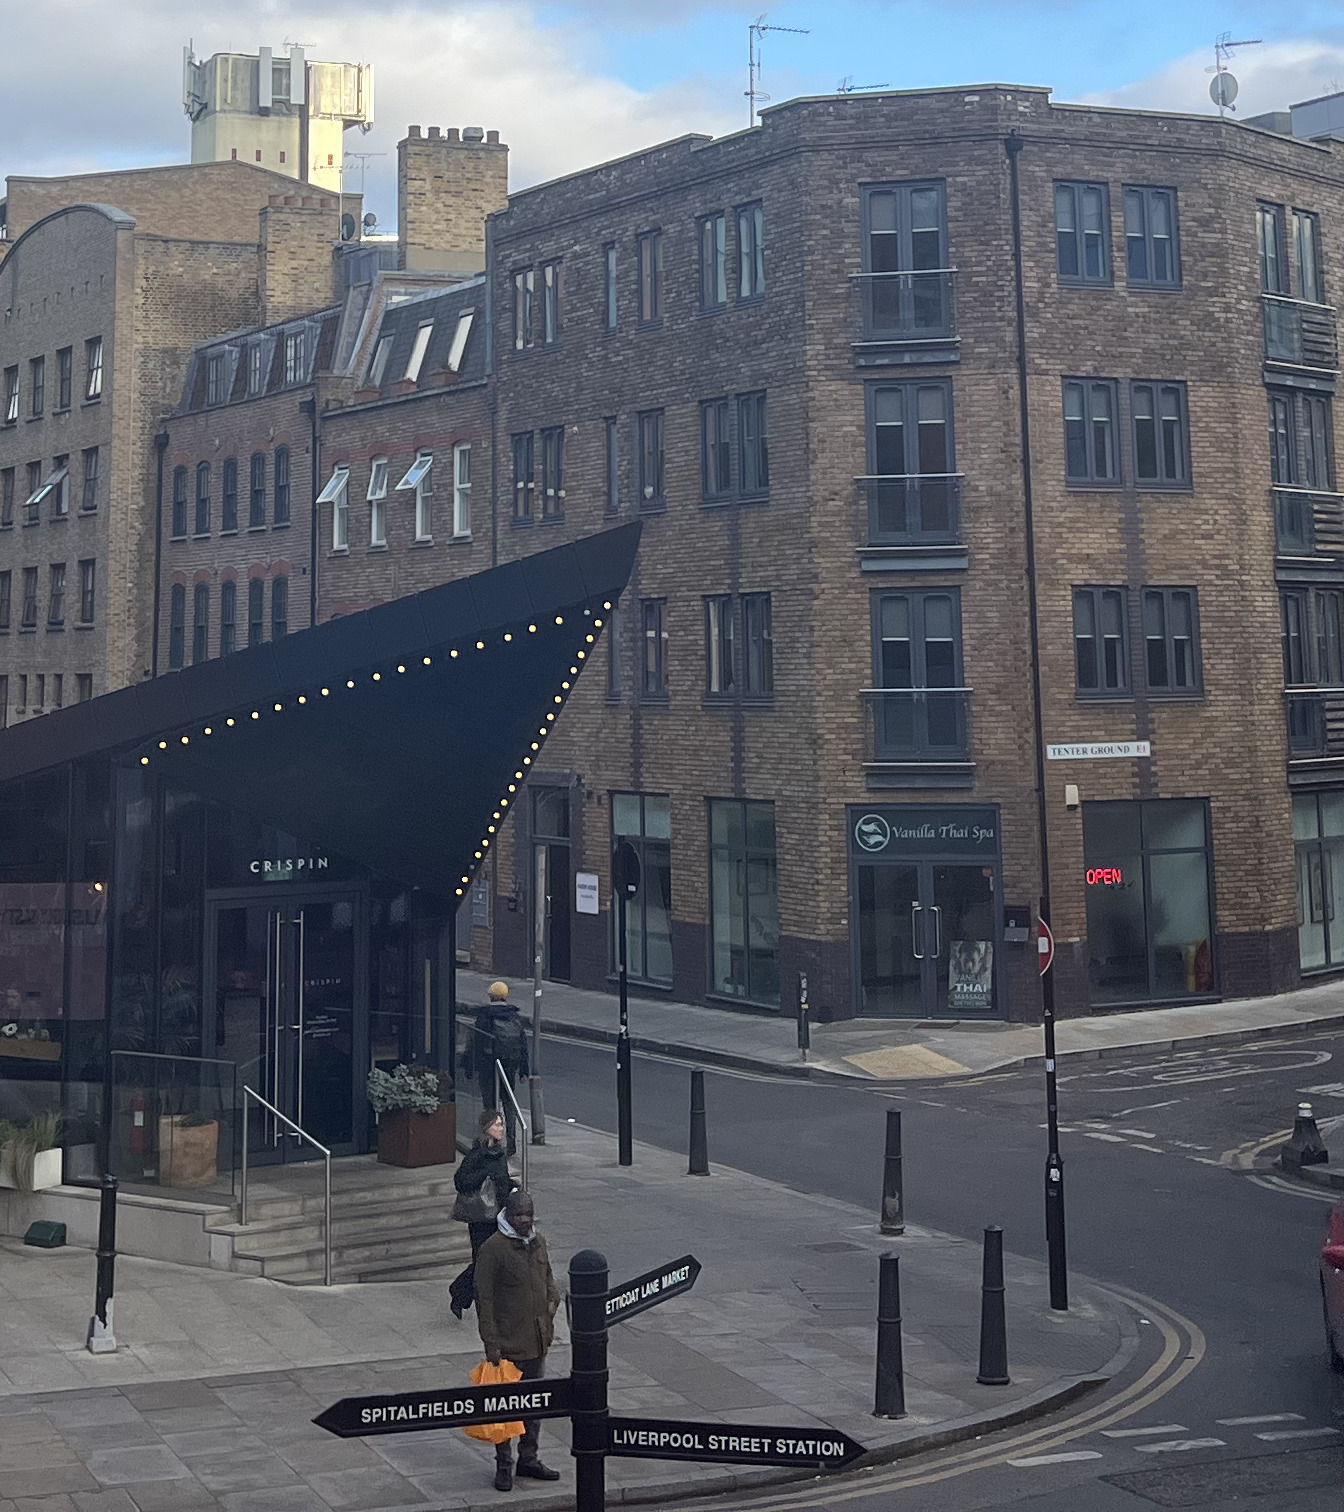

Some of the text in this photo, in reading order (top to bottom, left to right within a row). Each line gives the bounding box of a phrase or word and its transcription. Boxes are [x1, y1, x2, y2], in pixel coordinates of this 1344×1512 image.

[1051, 746, 1088, 757] TENTER
[1090, 744, 1130, 755] GROUND
[892, 823, 994, 844] Vanilla Thai Spa
[249, 856, 328, 873] CRISPIN
[1086, 868, 1122, 885] OPEN
[955, 983, 987, 993] THAI
[605, 1265, 690, 1315] ETTICOAT LANE MARKET
[361, 1392, 552, 1423] SPITALFIELDS MARKET
[613, 1429, 845, 1457] LIVERPOOL STREET STATION
